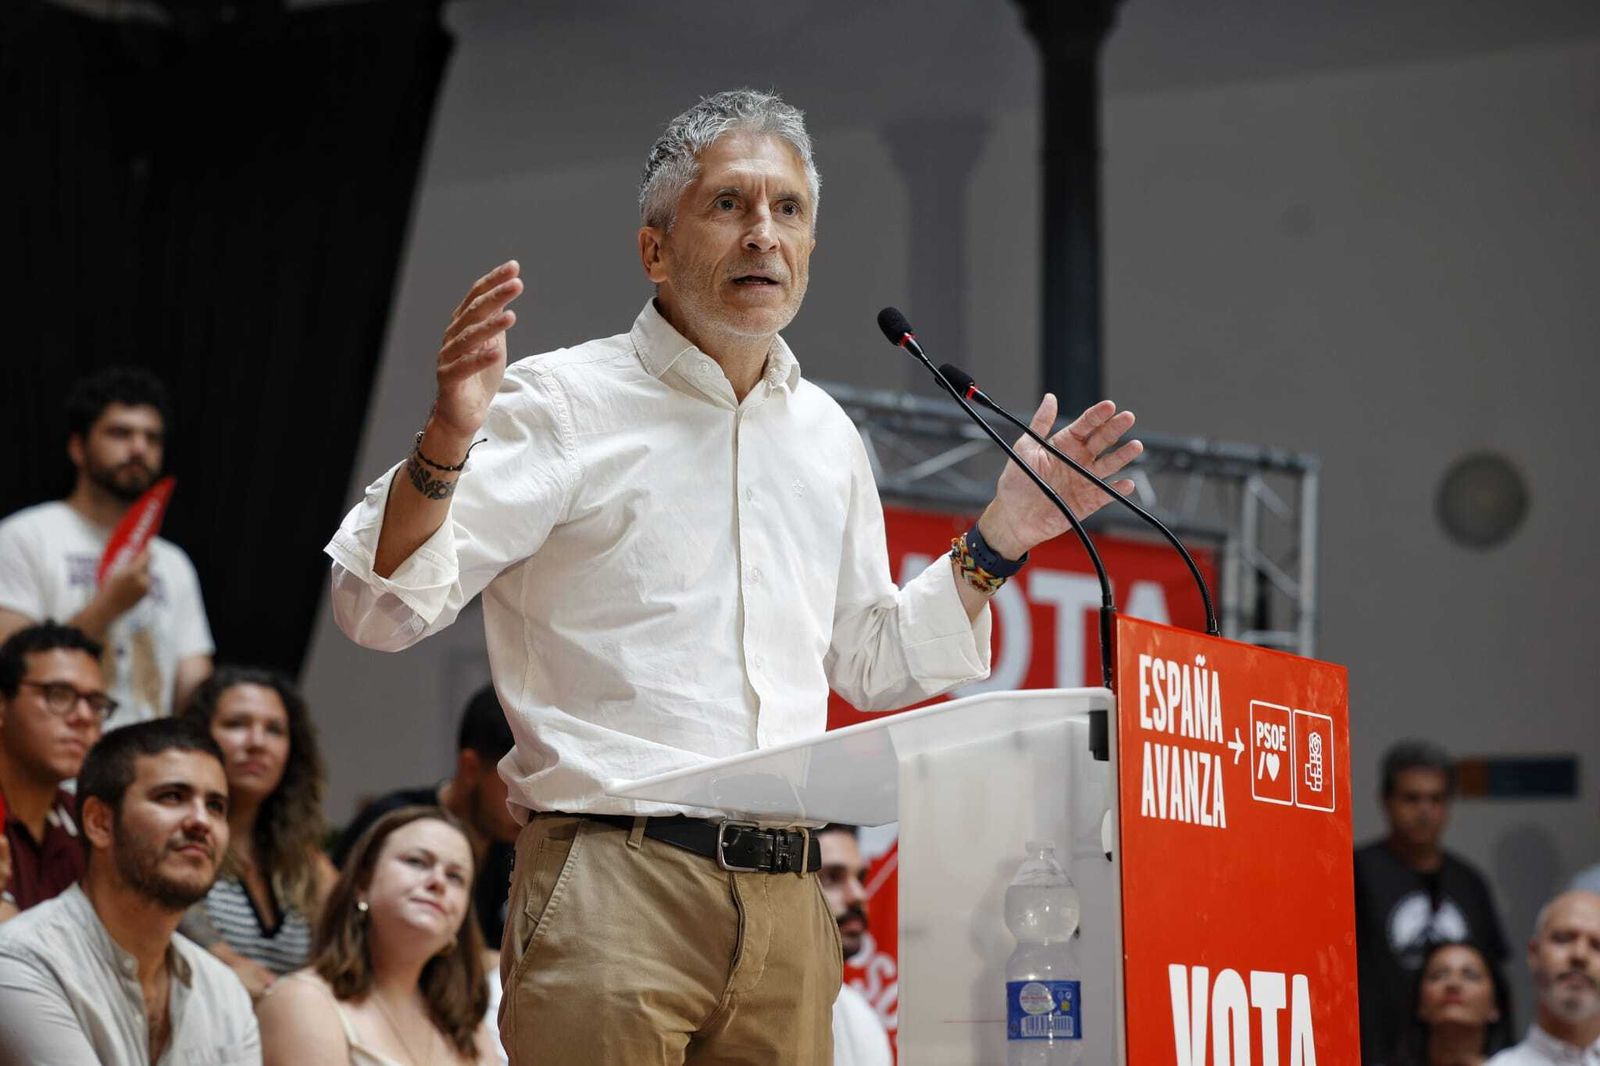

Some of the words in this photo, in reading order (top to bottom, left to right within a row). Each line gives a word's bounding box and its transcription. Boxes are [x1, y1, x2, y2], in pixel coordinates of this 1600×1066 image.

[1139, 654, 1223, 743] ESPAÑA
[1256, 721, 1286, 751] PSOE
[1141, 741, 1226, 828] AVANZA
[1168, 963, 1317, 1066] VOTA
